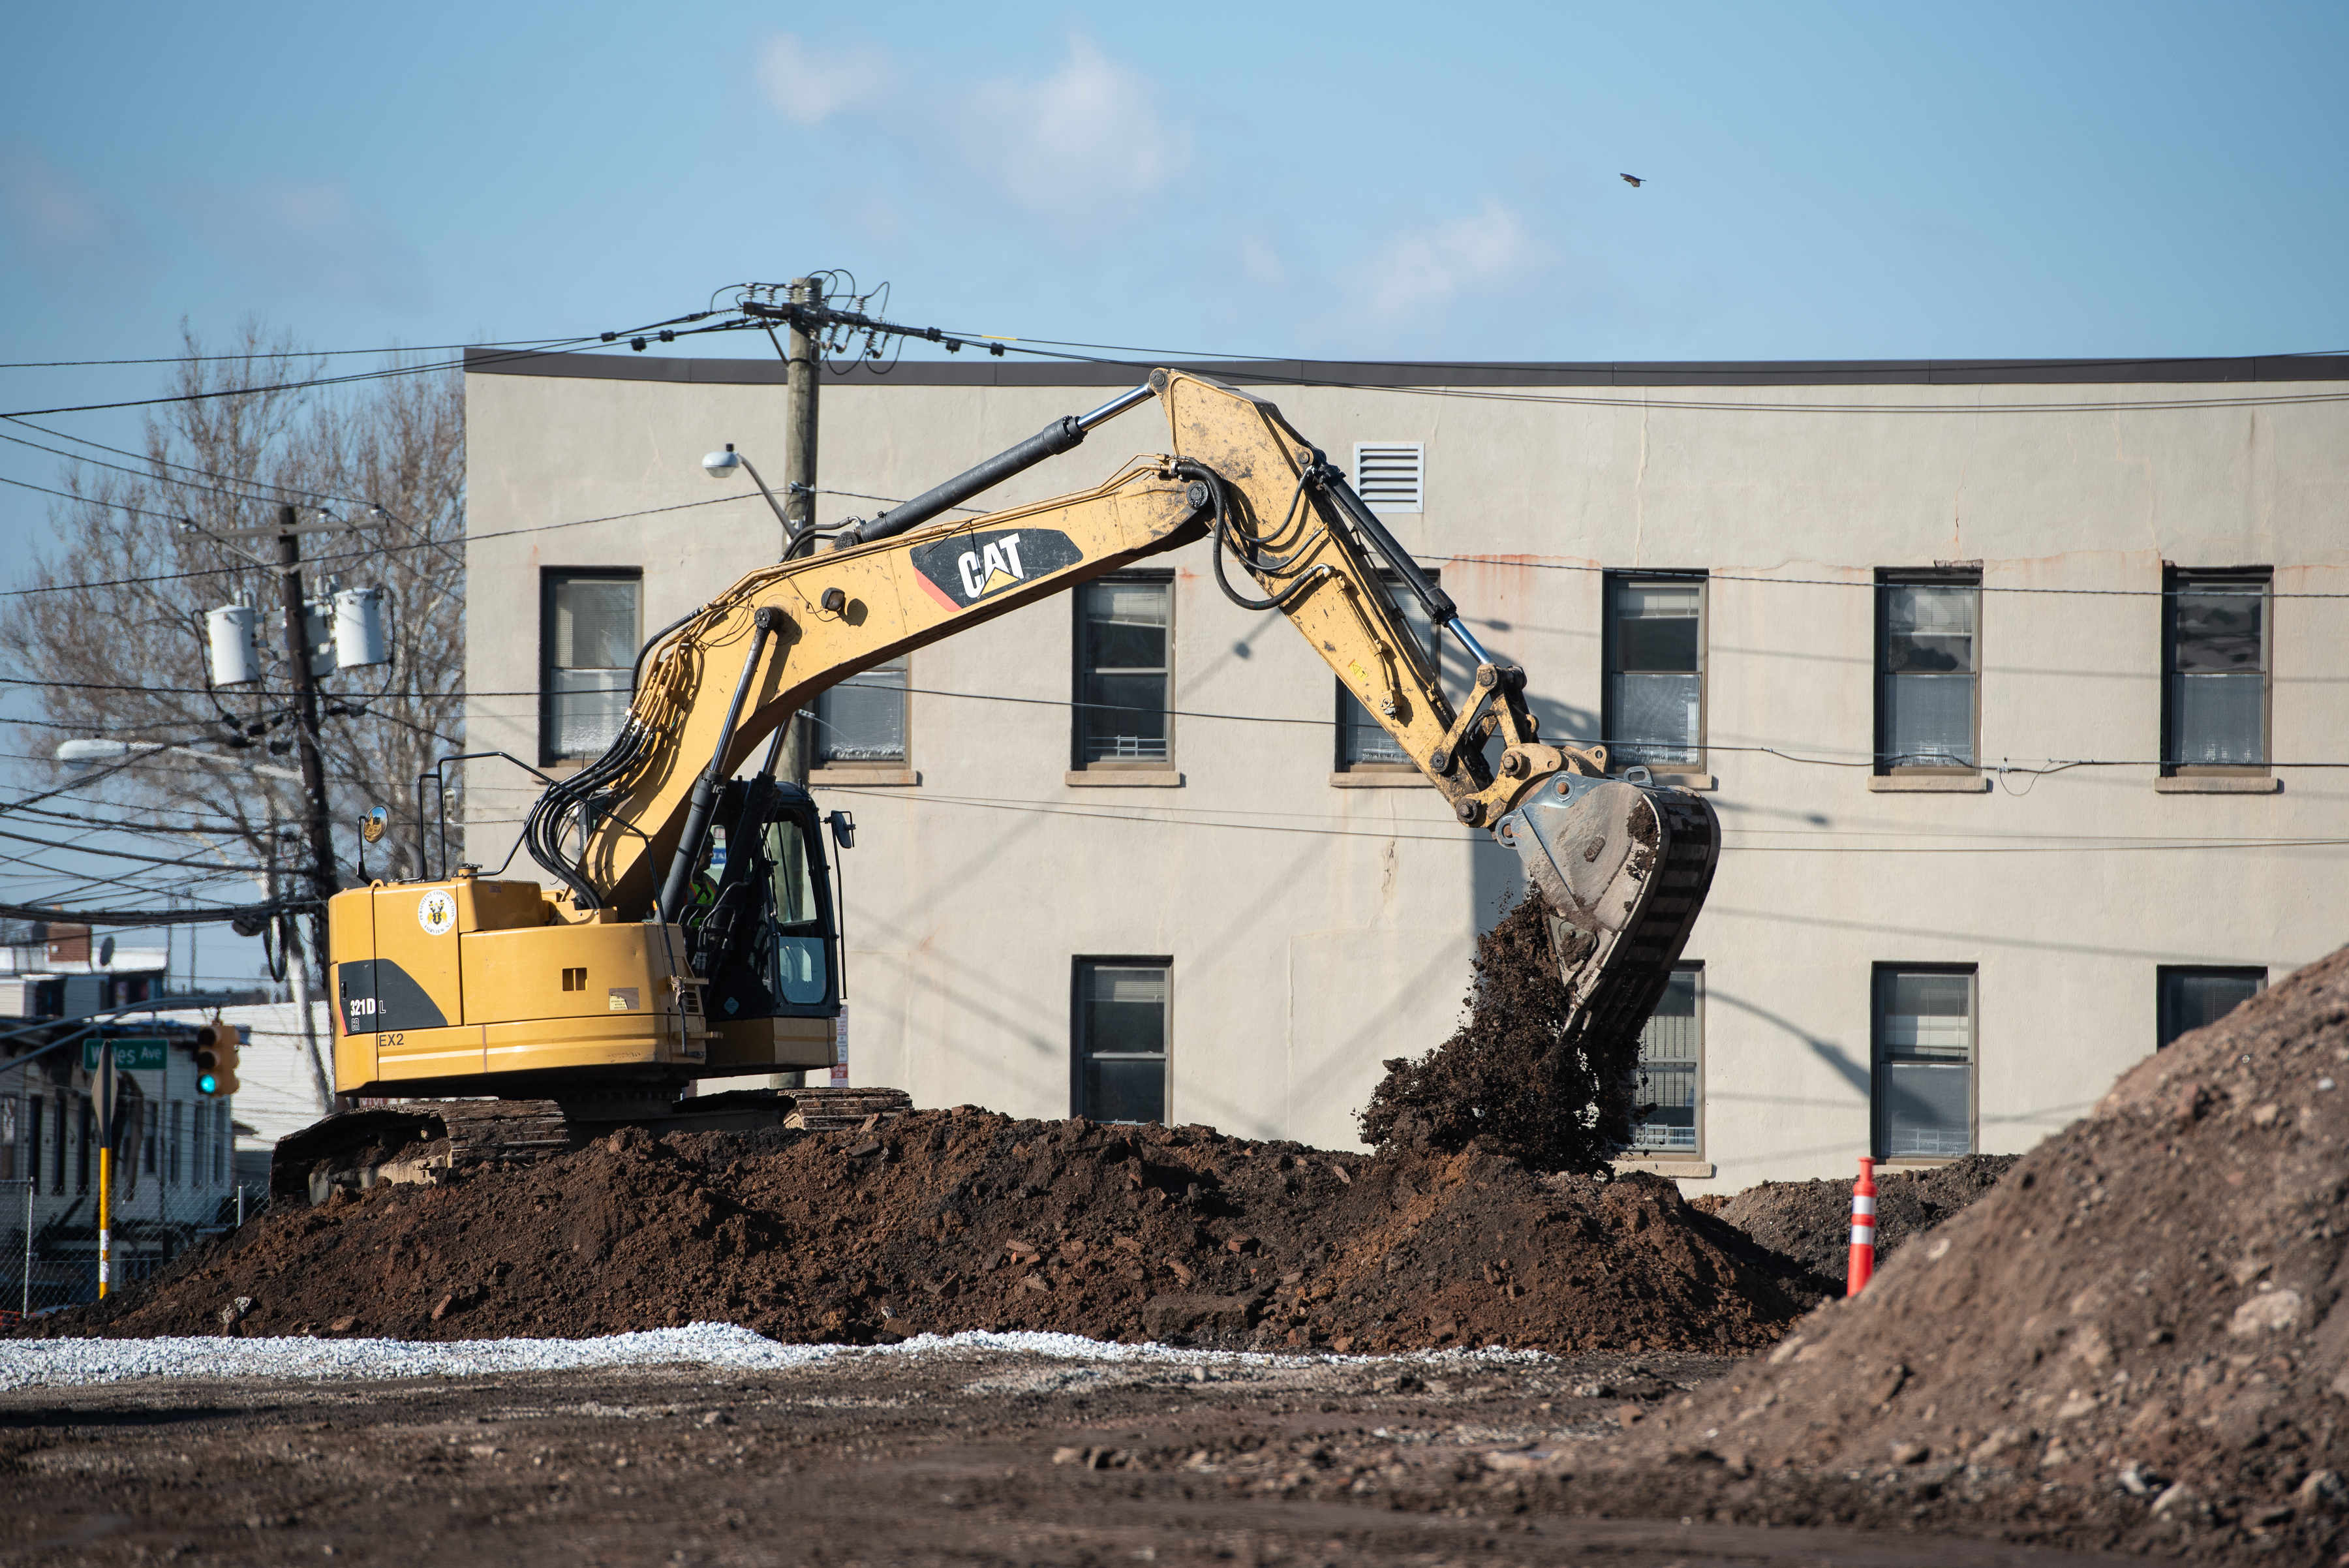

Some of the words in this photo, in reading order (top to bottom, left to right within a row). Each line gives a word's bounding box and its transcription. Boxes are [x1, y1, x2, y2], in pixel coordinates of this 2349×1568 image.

[958, 532, 1024, 598] CAT
[419, 893, 433, 921] PERSISTENT
[433, 891, 455, 917] CONSTRUCTION
[424, 925, 445, 934] FAIRVIEW
[350, 998, 376, 1017] 321D
[379, 1000, 386, 1014] L
[351, 1018, 360, 1032] CR
[378, 1033, 405, 1047] EX2
[91, 1045, 136, 1065] Wles
[140, 1046, 162, 1060] Ave
